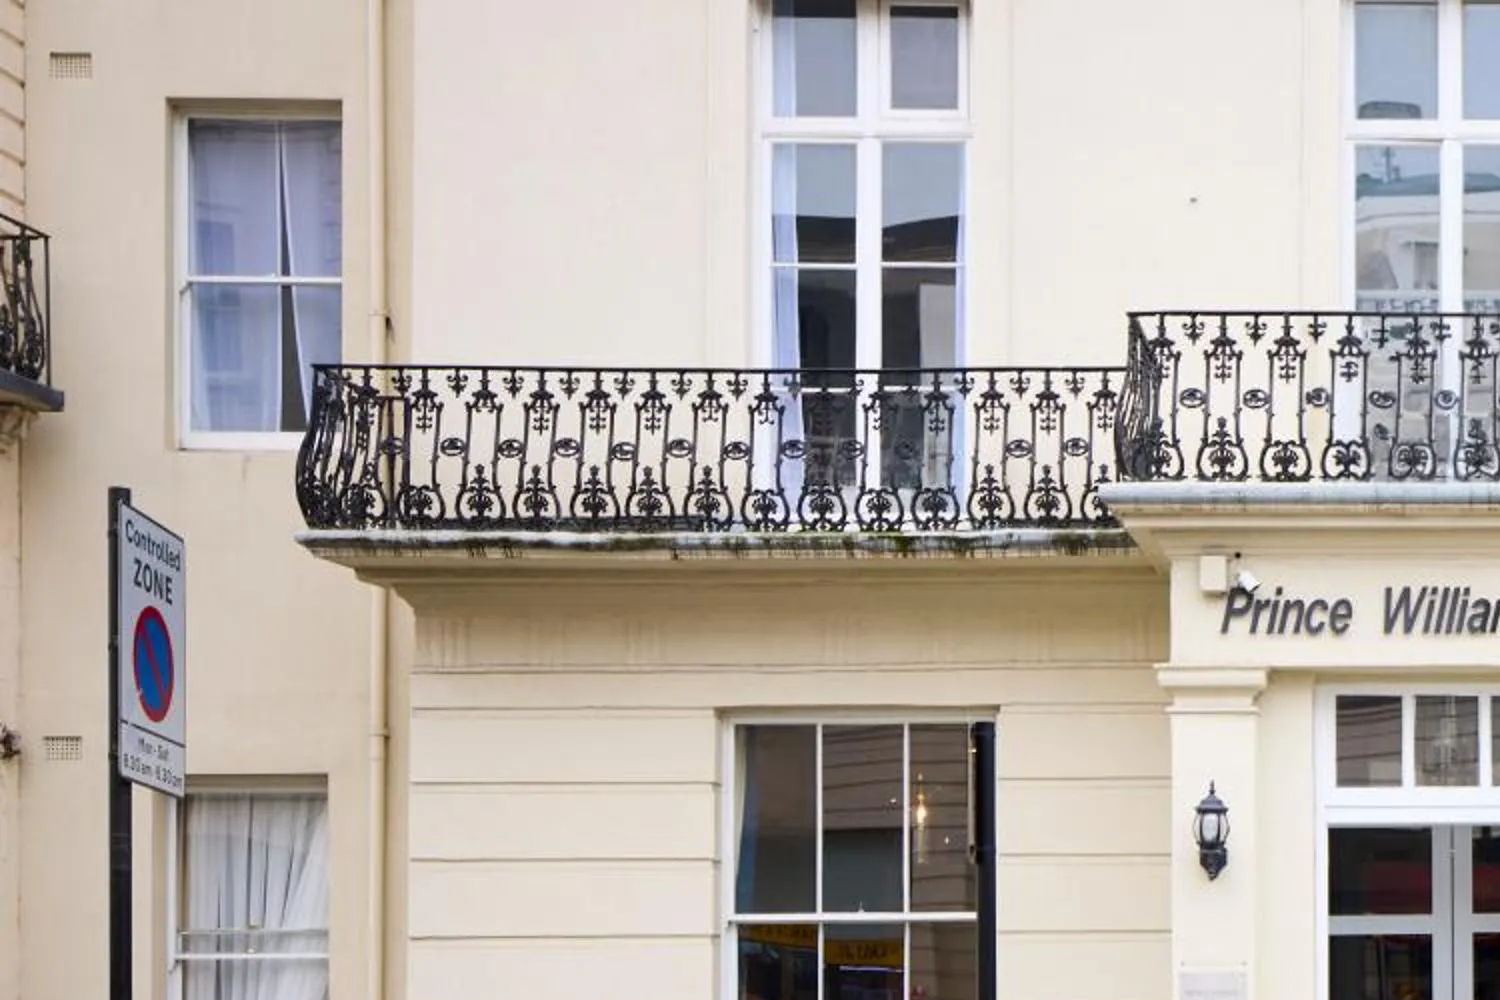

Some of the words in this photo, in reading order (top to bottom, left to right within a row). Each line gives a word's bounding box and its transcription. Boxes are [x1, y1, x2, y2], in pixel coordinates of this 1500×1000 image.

[125, 519, 181, 572] Controlled
[133, 559, 173, 605] ZONE
[1221, 586, 1353, 636] Prince
